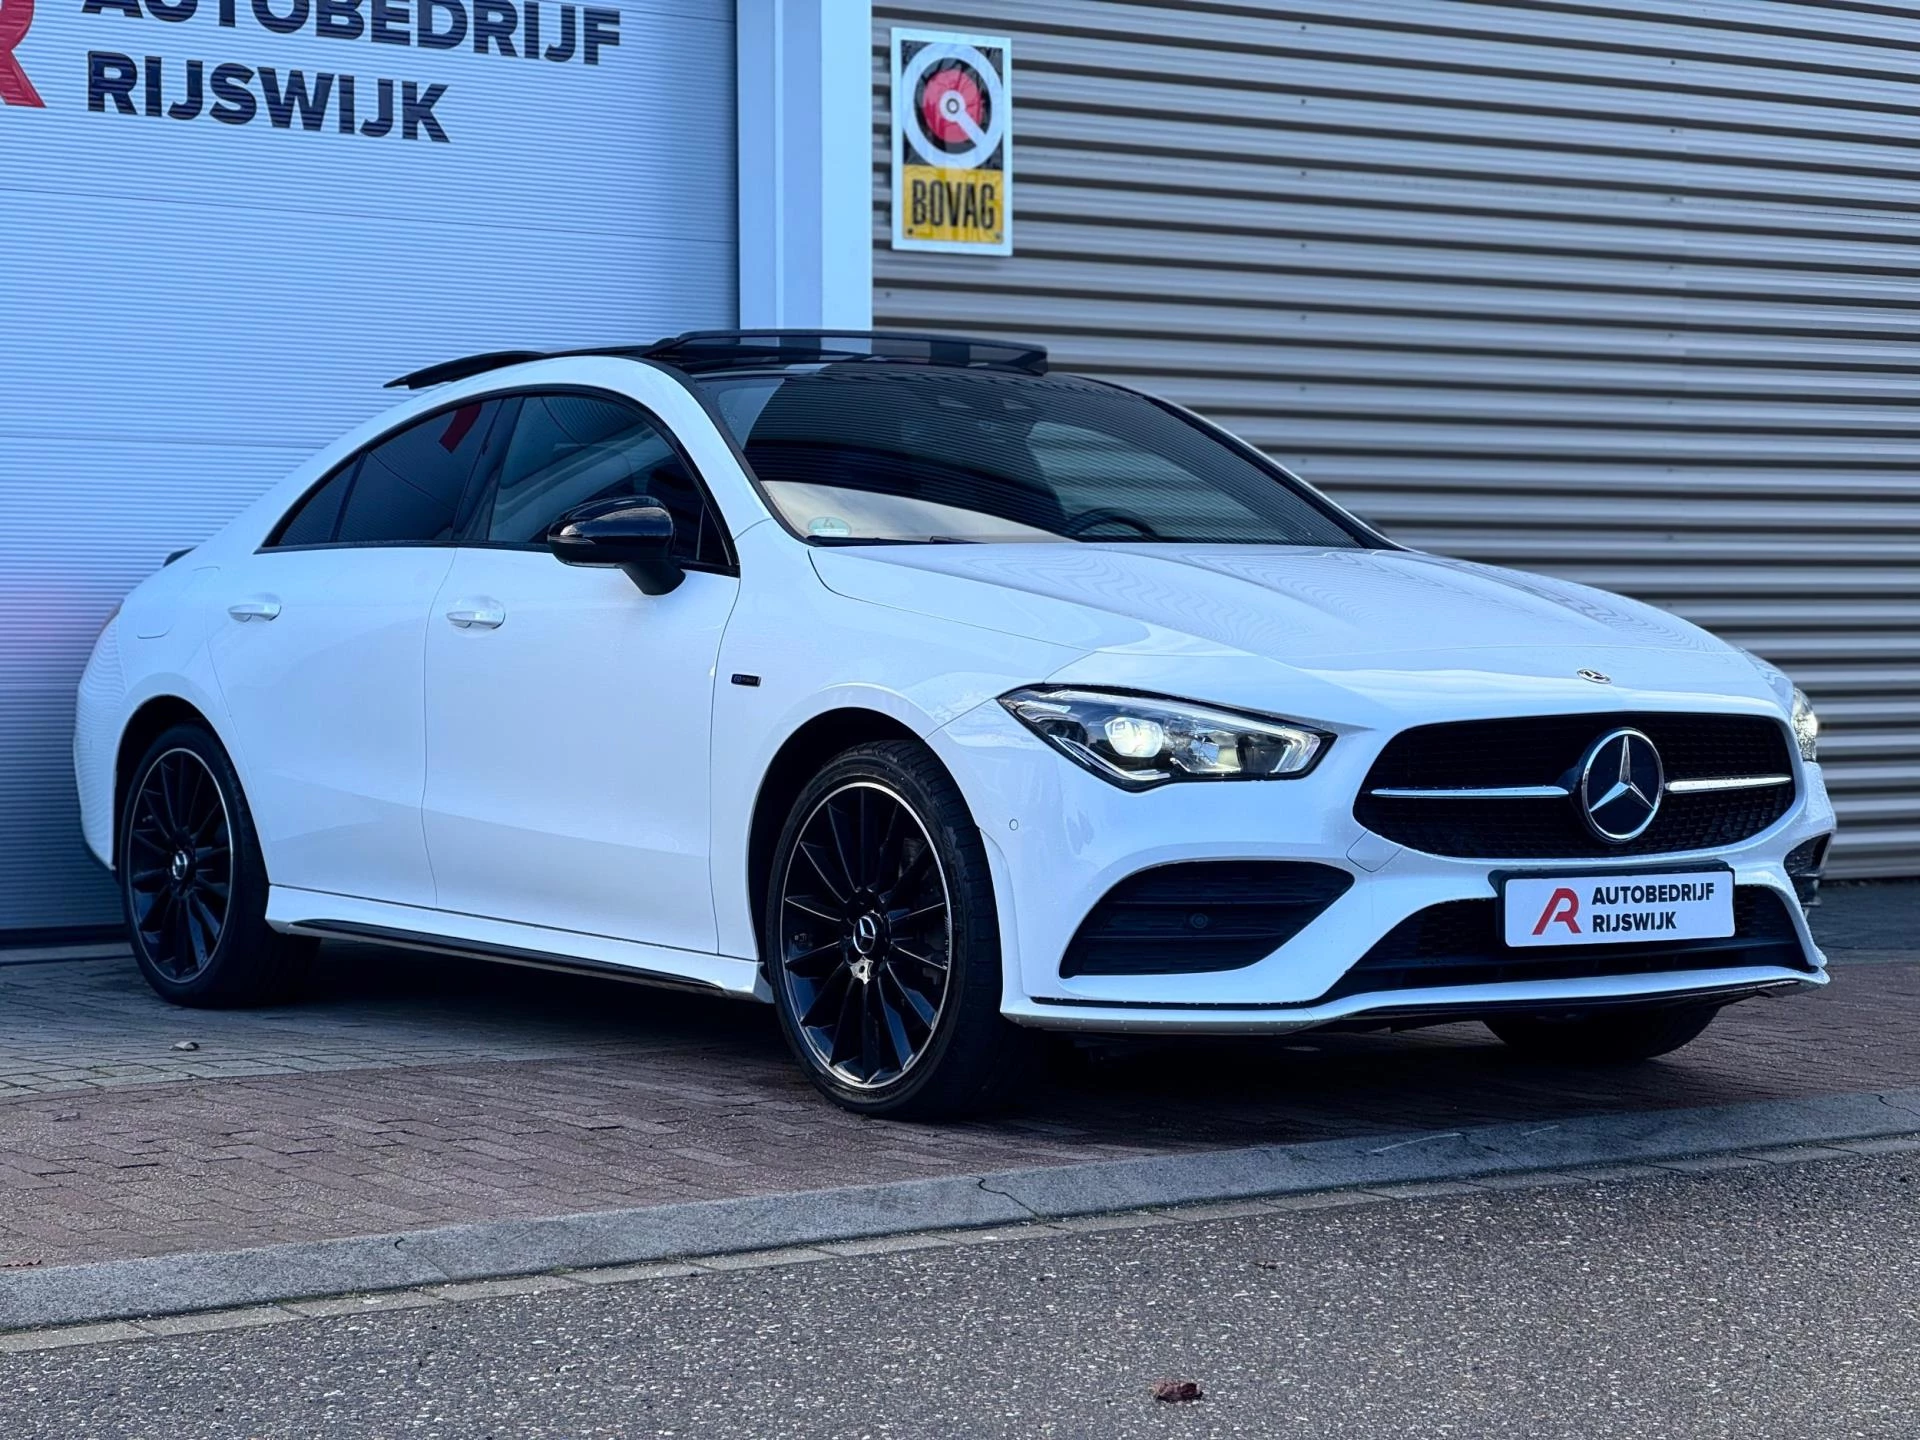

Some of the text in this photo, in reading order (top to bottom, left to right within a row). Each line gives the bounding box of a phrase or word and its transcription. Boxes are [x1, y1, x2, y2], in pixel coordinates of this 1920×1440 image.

[82, 0, 621, 65] OBEDRIJF
[86, 50, 451, 143] RIJSWIJK
[911, 179, 995, 229] BOVAG
[1591, 882, 1715, 905] AUTOBEDRIJF
[1592, 911, 1677, 933] RIJSWIJK
